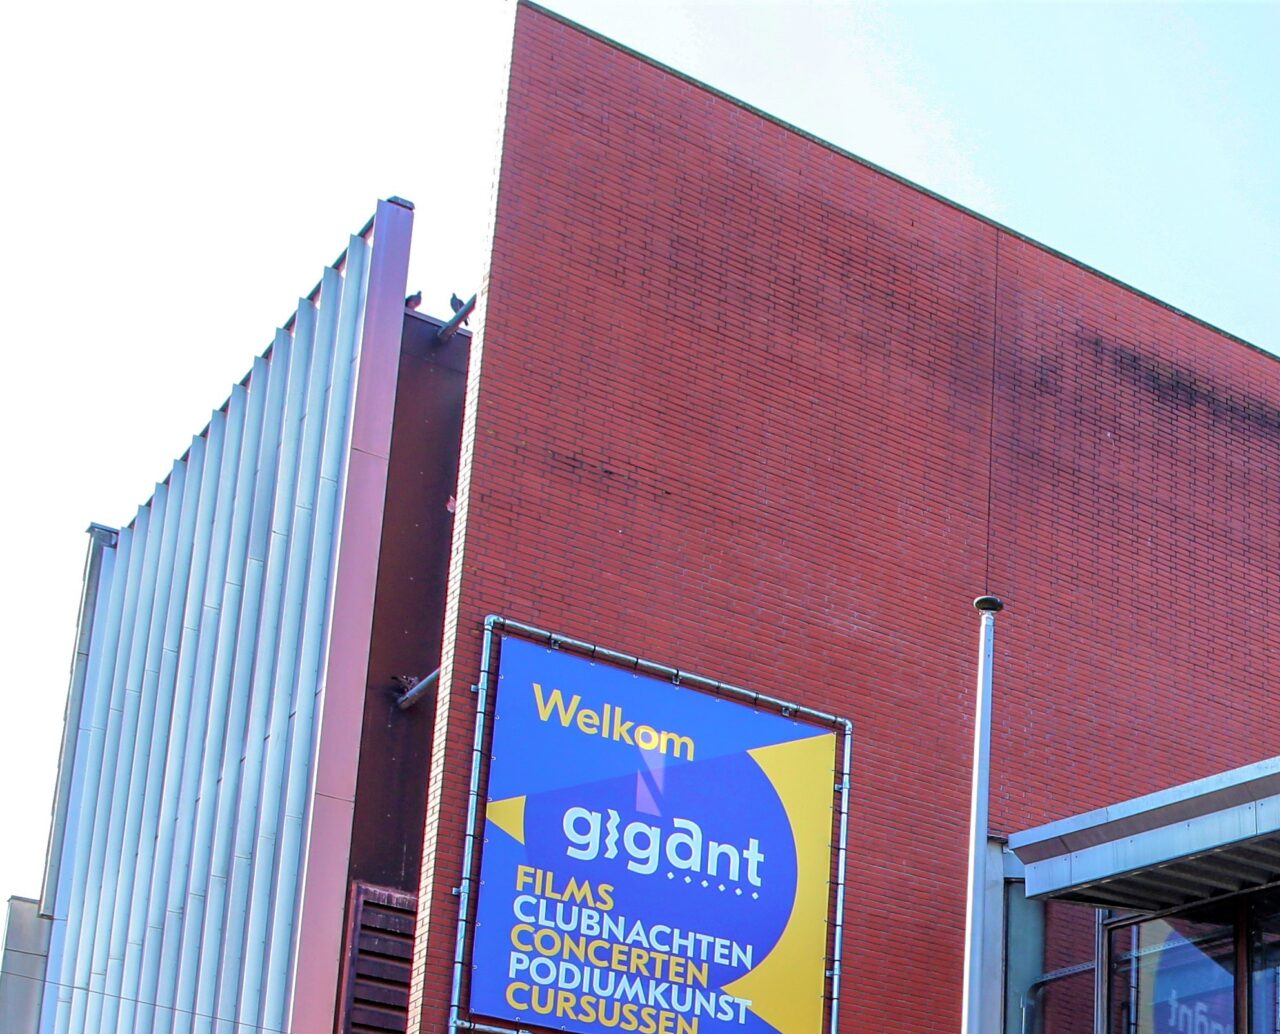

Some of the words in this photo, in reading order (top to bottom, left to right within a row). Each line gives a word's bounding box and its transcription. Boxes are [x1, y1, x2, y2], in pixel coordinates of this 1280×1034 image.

[532, 682, 696, 762] Welkom
[562, 805, 766, 888] gigant
[515, 864, 615, 911] FILMS
[509, 925, 709, 988] CONCERTEN
[512, 894, 753, 970] CLUBNACHTEN
[508, 951, 753, 1025] PODIUMKUNST
